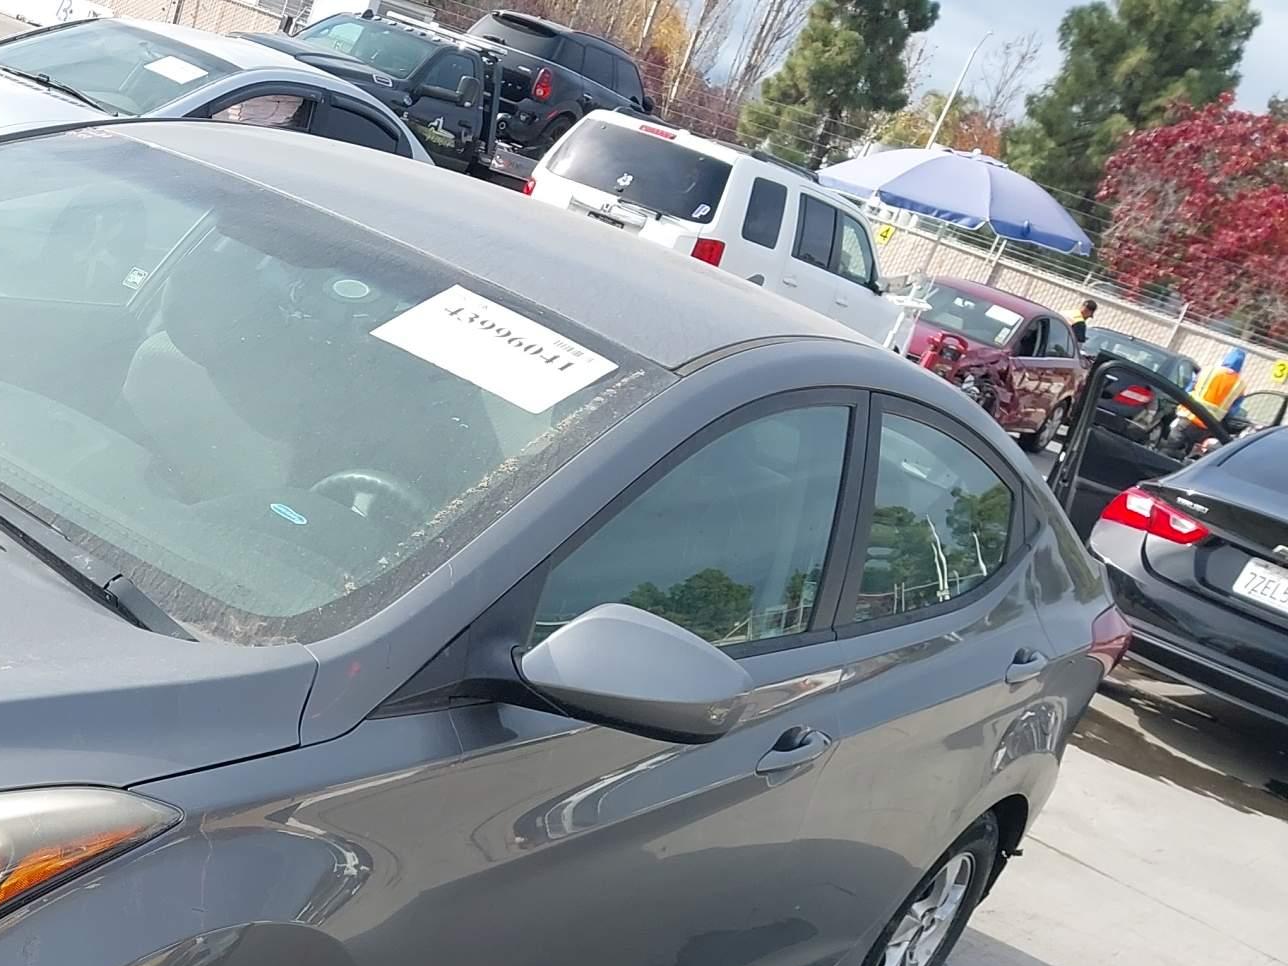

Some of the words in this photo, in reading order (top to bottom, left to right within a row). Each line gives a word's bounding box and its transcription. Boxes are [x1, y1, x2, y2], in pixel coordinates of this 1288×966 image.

[879, 226, 891, 241] 4
[442, 307, 576, 372] 43996041
[1272, 362, 1287, 379] 3
